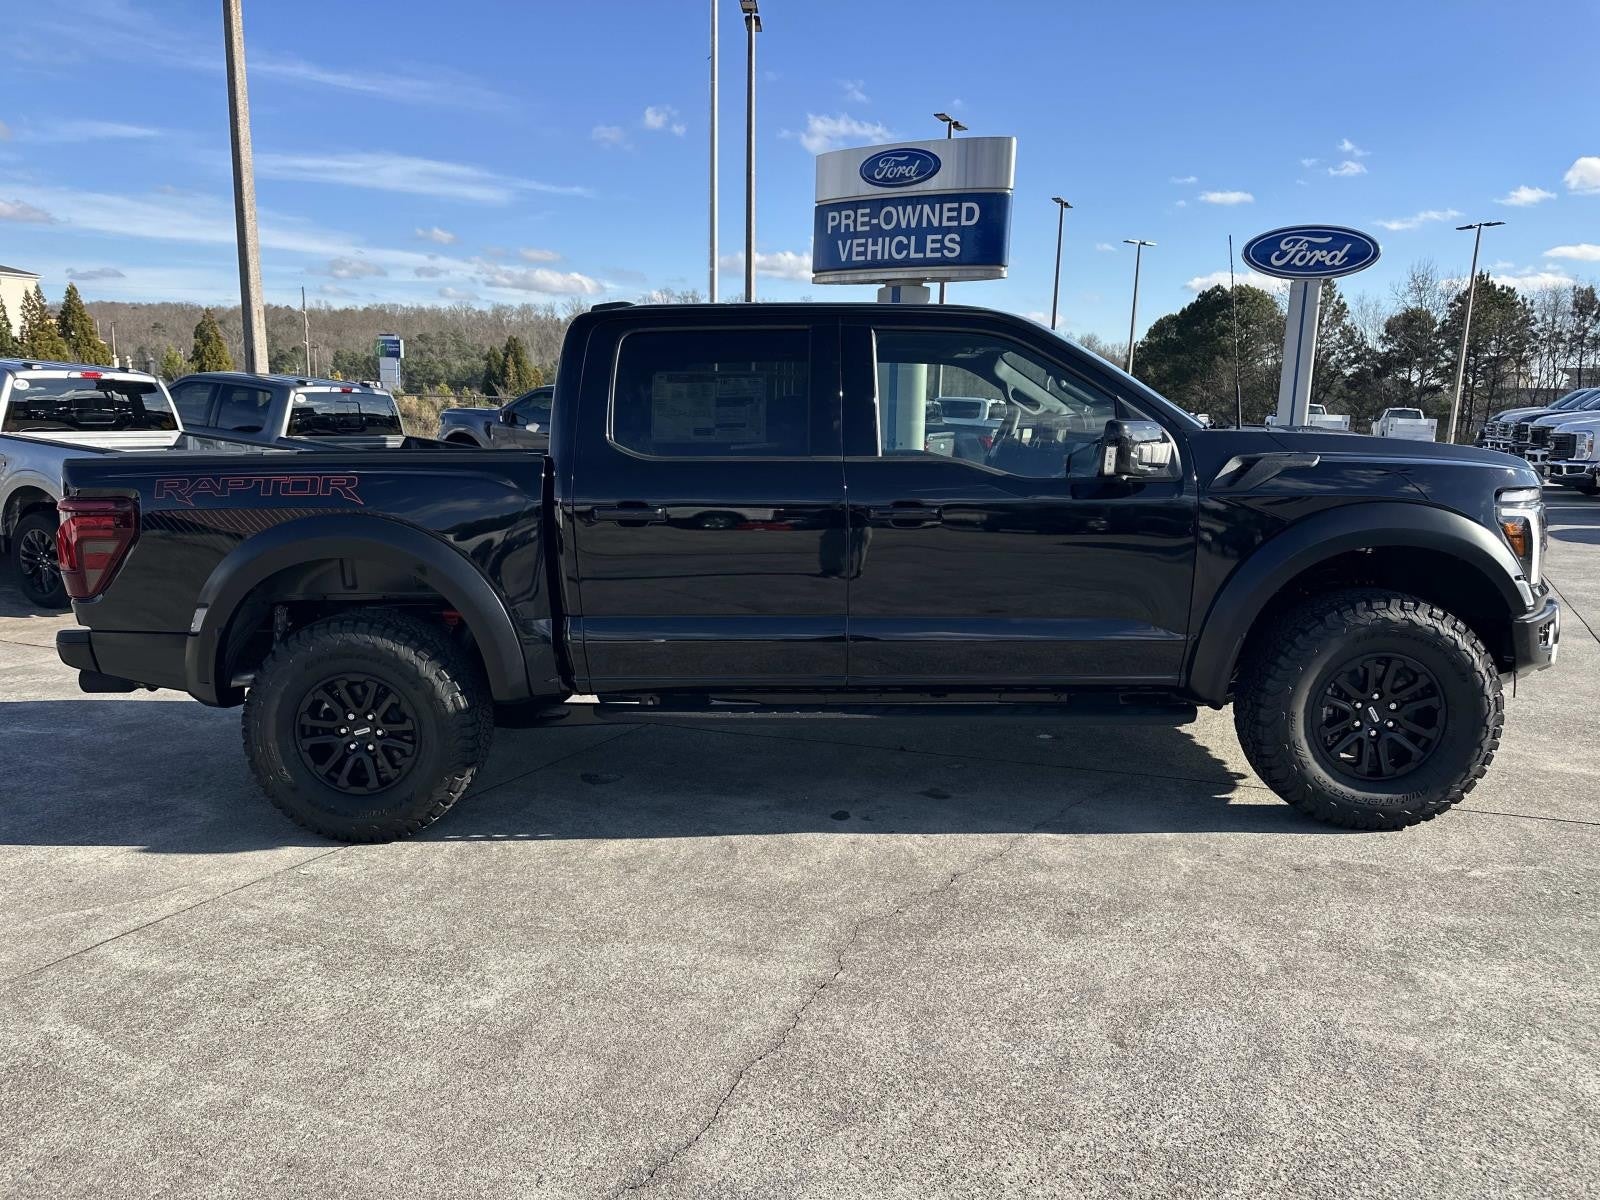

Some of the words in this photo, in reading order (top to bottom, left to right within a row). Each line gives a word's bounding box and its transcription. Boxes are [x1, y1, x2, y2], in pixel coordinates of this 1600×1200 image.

[874, 155, 921, 180] Ford
[827, 202, 980, 235] PRE-OWNED
[837, 233, 961, 262] VEHICLES
[1270, 235, 1352, 267] Ford
[154, 475, 365, 507] RAPTOR
